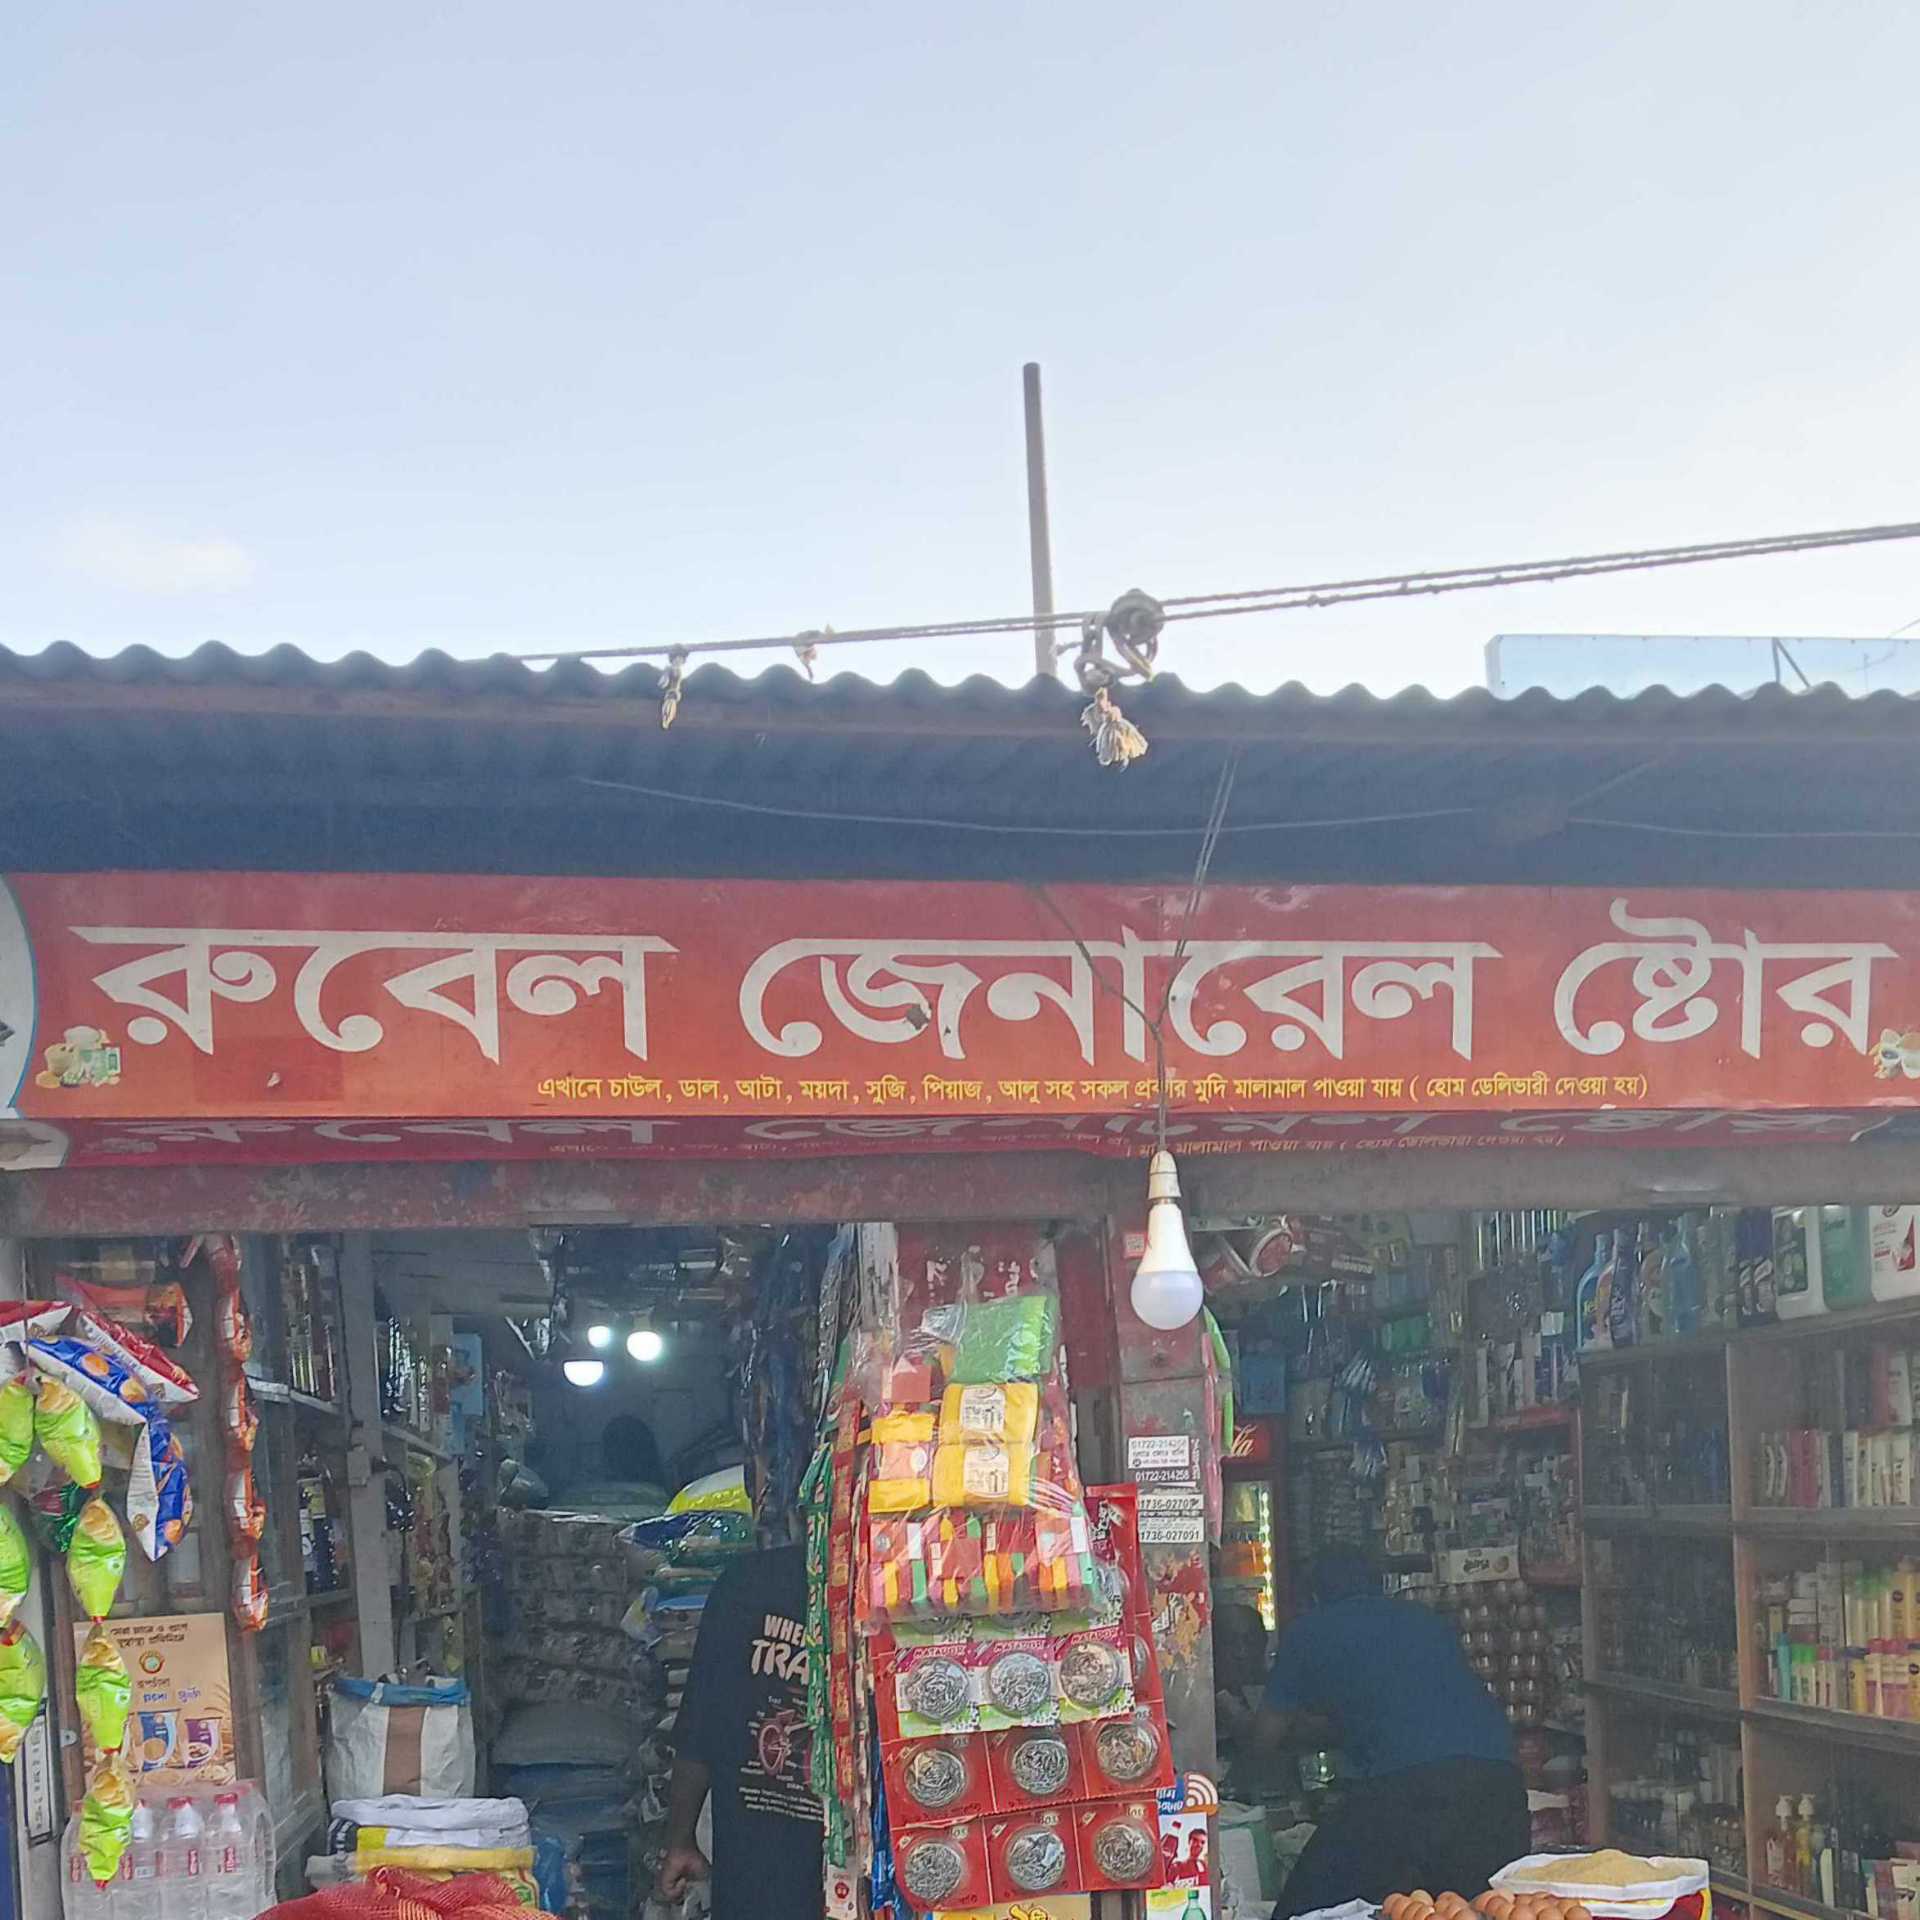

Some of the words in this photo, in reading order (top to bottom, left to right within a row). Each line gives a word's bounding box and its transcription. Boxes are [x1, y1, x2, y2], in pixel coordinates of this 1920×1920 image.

[68, 926, 680, 1064] রুবেল
[740, 926, 1503, 1066] জেনারেল
[538, 1075, 602, 1099] এখানে
[998, 1078, 1041, 1104] আলু
[1046, 1080, 1076, 1101] সহ
[1081, 1079, 1129, 1100] সকল
[1193, 1073, 1228, 1103] মুদি
[1233, 1078, 1307, 1100] মালামাল
[1313, 1078, 1366, 1099] পাওয়া
